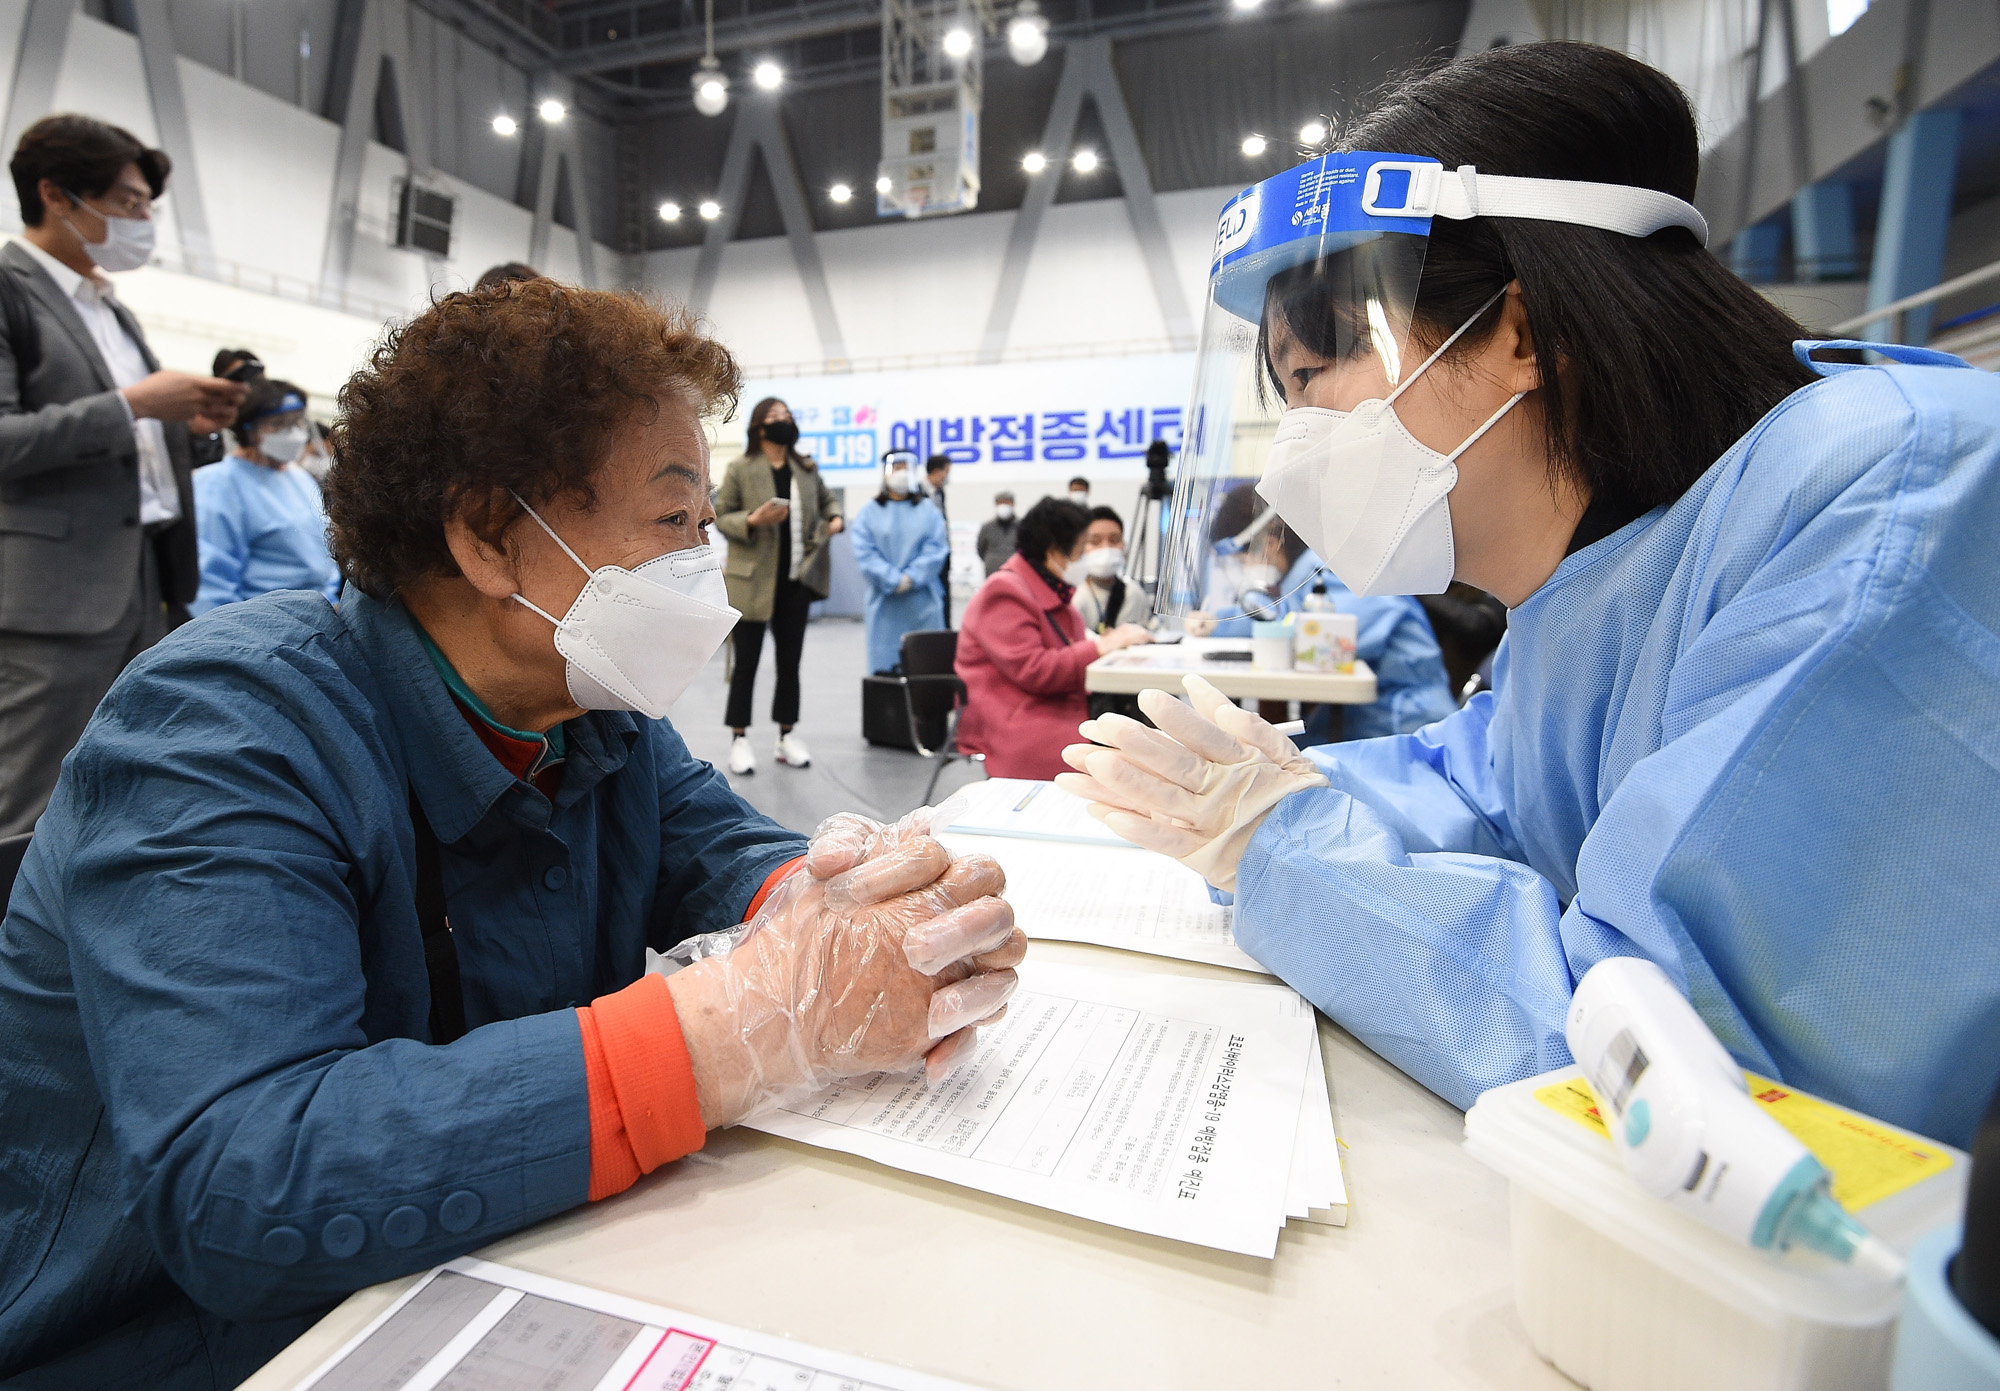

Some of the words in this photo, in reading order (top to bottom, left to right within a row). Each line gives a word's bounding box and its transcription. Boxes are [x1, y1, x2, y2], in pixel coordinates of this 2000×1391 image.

[889, 403, 1205, 465] 예방접종센터
[1200, 1033, 1247, 1122] 코로나바이러스감염증-19
[1185, 1123, 1219, 1165] 예방접종
[1173, 1166, 1205, 1202] 예진표
